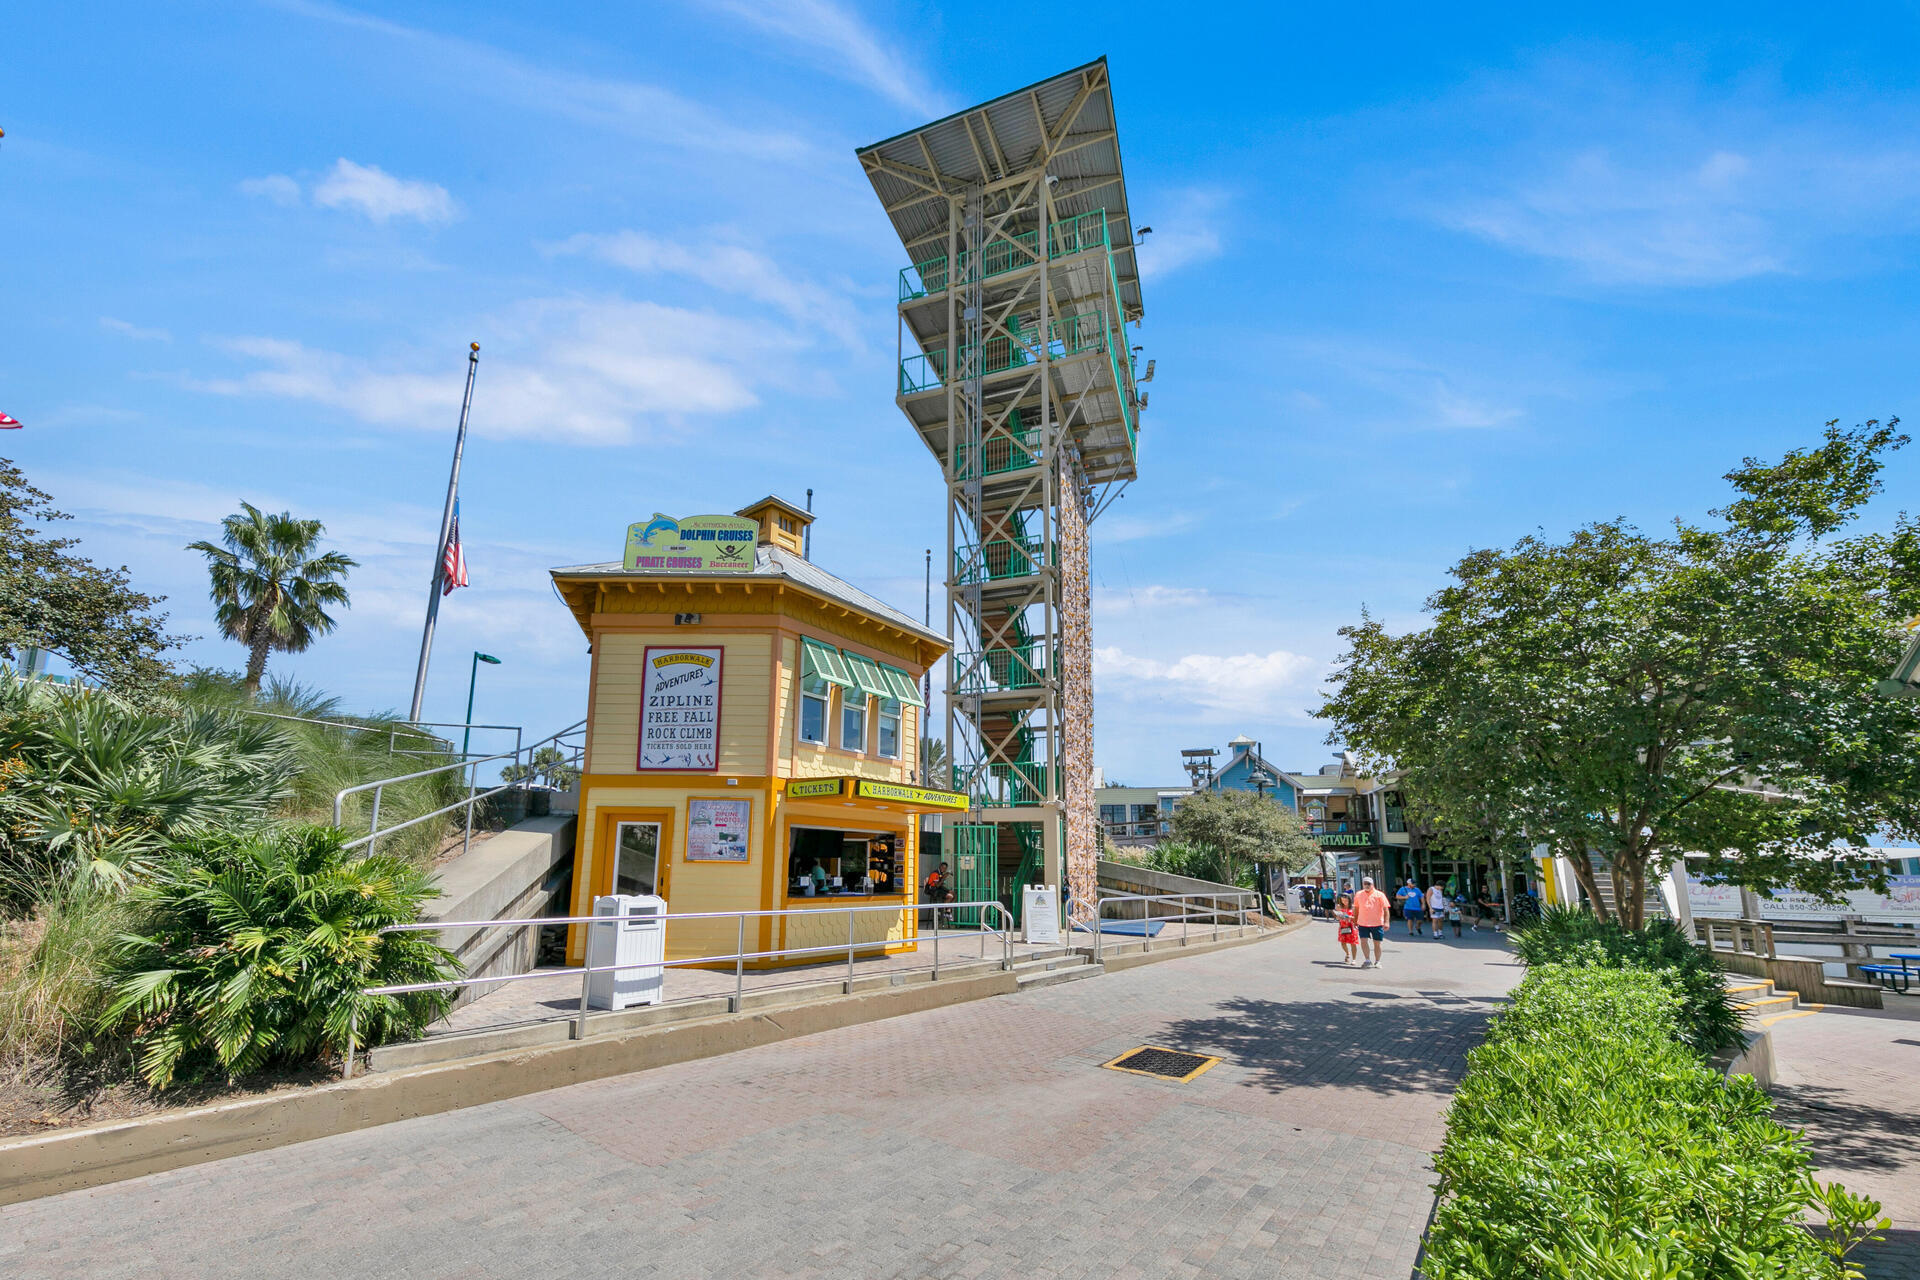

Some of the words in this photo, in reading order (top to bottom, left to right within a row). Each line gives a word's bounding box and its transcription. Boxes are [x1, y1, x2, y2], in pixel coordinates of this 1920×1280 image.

[680, 529, 716, 541] DOLPHIN
[717, 530, 753, 541] CRUISES
[636, 556, 665, 568] PIRATE
[666, 556, 702, 569] CRUISES
[657, 654, 711, 666] HARBORWALK
[655, 668, 704, 693] ADVENTURES
[649, 695, 713, 707] ZIPLINE
[648, 711, 678, 723] FREE
[684, 711, 714, 722] FALL
[647, 727, 676, 739] ROCK
[680, 727, 713, 739] CLIMB
[799, 783, 834, 795] TICKETS
[872, 785, 913, 799] HARBORWALK
[924, 792, 958, 804] ADVENTURES
